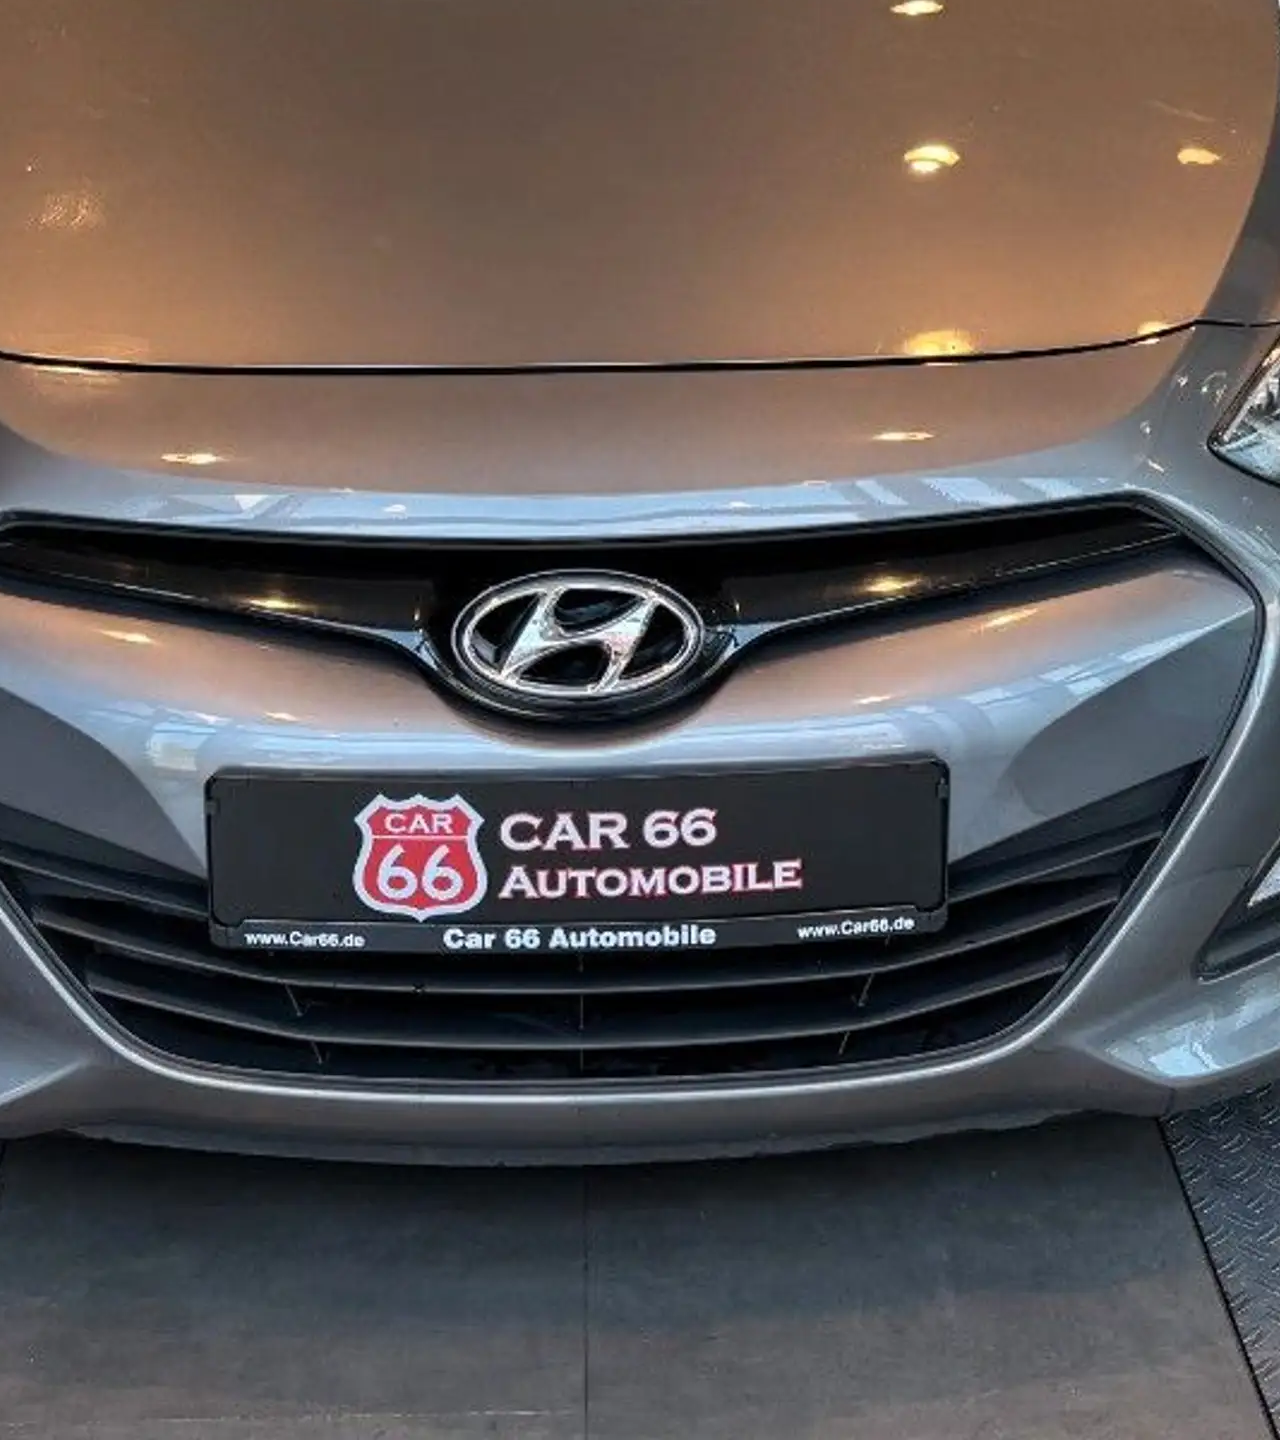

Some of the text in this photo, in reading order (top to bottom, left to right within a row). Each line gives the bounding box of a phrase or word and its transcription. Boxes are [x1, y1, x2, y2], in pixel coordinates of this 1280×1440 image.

[384, 813, 453, 835] CAR
[499, 808, 718, 852] CAR 66
[376, 843, 465, 901] 66
[497, 858, 803, 900] AUTOMOBILE
[244, 929, 366, 948] www.Car66.de
[442, 924, 717, 950] Car 66 Automobile
[797, 916, 916, 940] www.Car66.de
